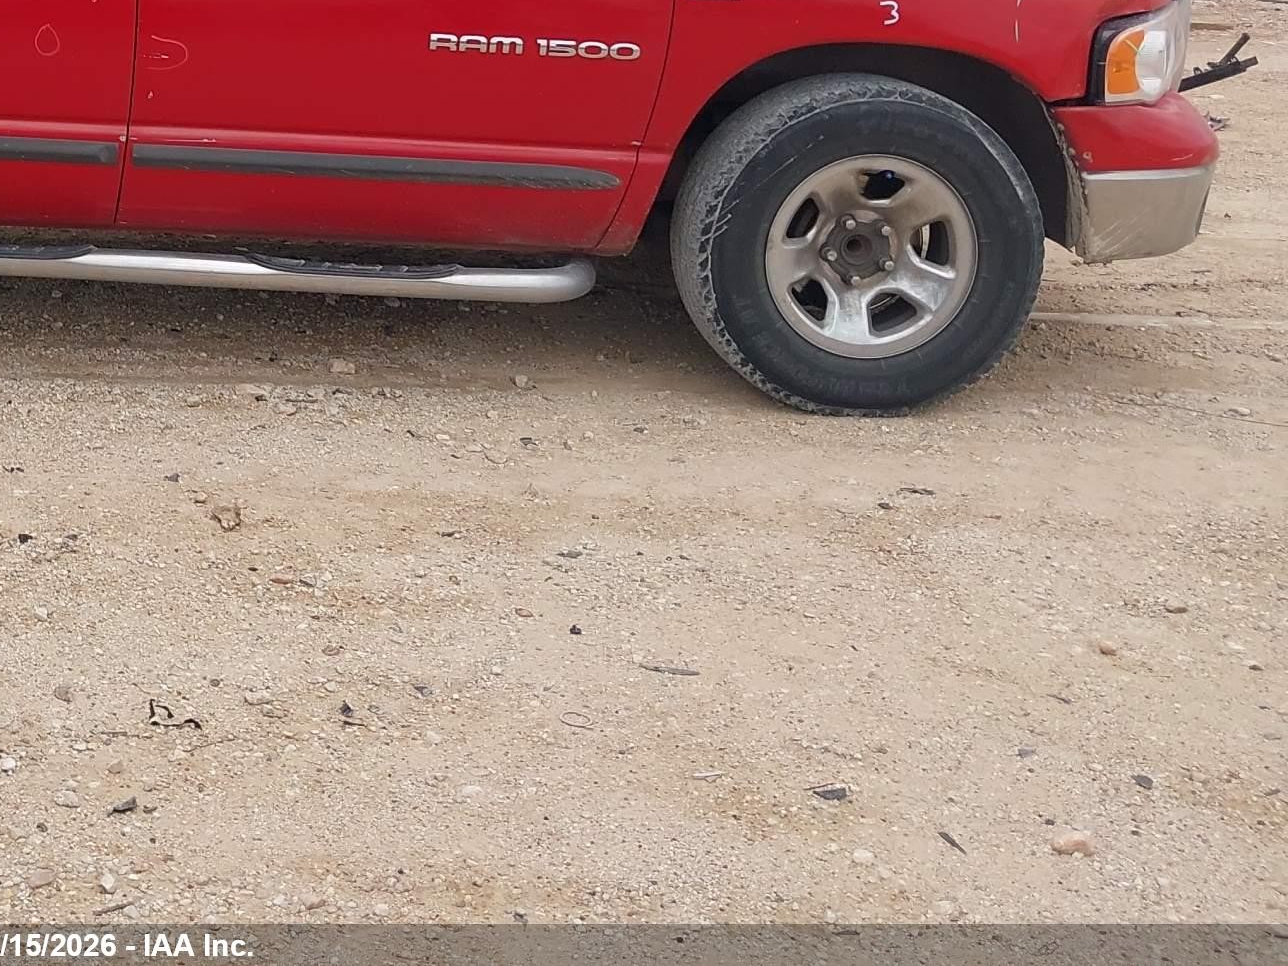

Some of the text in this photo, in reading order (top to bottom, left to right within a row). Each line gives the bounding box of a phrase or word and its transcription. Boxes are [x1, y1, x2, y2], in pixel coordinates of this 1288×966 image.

[879, 0, 900, 25] 3
[429, 33, 641, 61] RAM 1500
